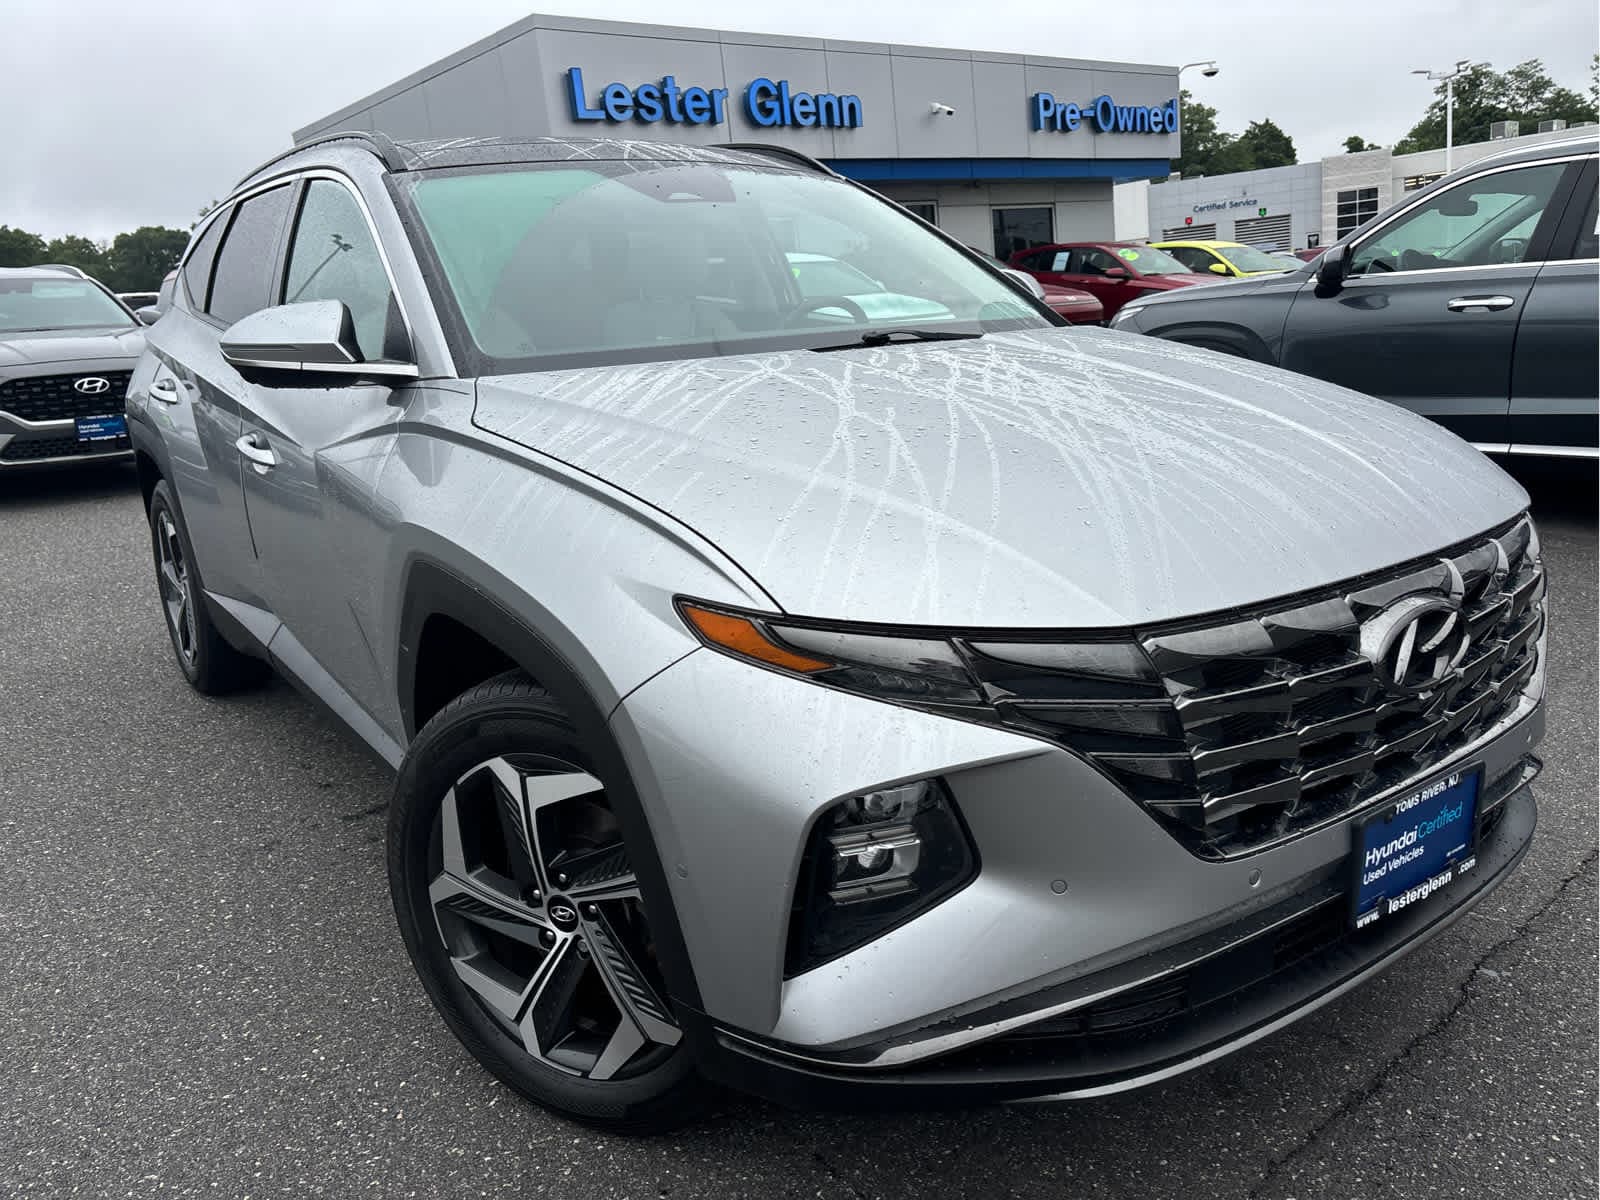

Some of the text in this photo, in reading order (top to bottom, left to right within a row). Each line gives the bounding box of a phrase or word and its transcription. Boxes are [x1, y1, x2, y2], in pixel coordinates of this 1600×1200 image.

[567, 66, 864, 128] Lester Glenn
[1031, 92, 1178, 134] Pre-Owned
[1193, 199, 1258, 213] Certified Service
[1395, 793, 1421, 815] TOMS
[1447, 774, 1460, 788] NJ
[1364, 800, 1463, 868] Hyundai Certified
[1363, 861, 1388, 885] Used
[1388, 845, 1424, 872] Vehicles
[1387, 870, 1452, 914] lesterglenn
[1457, 858, 1476, 875] .com
